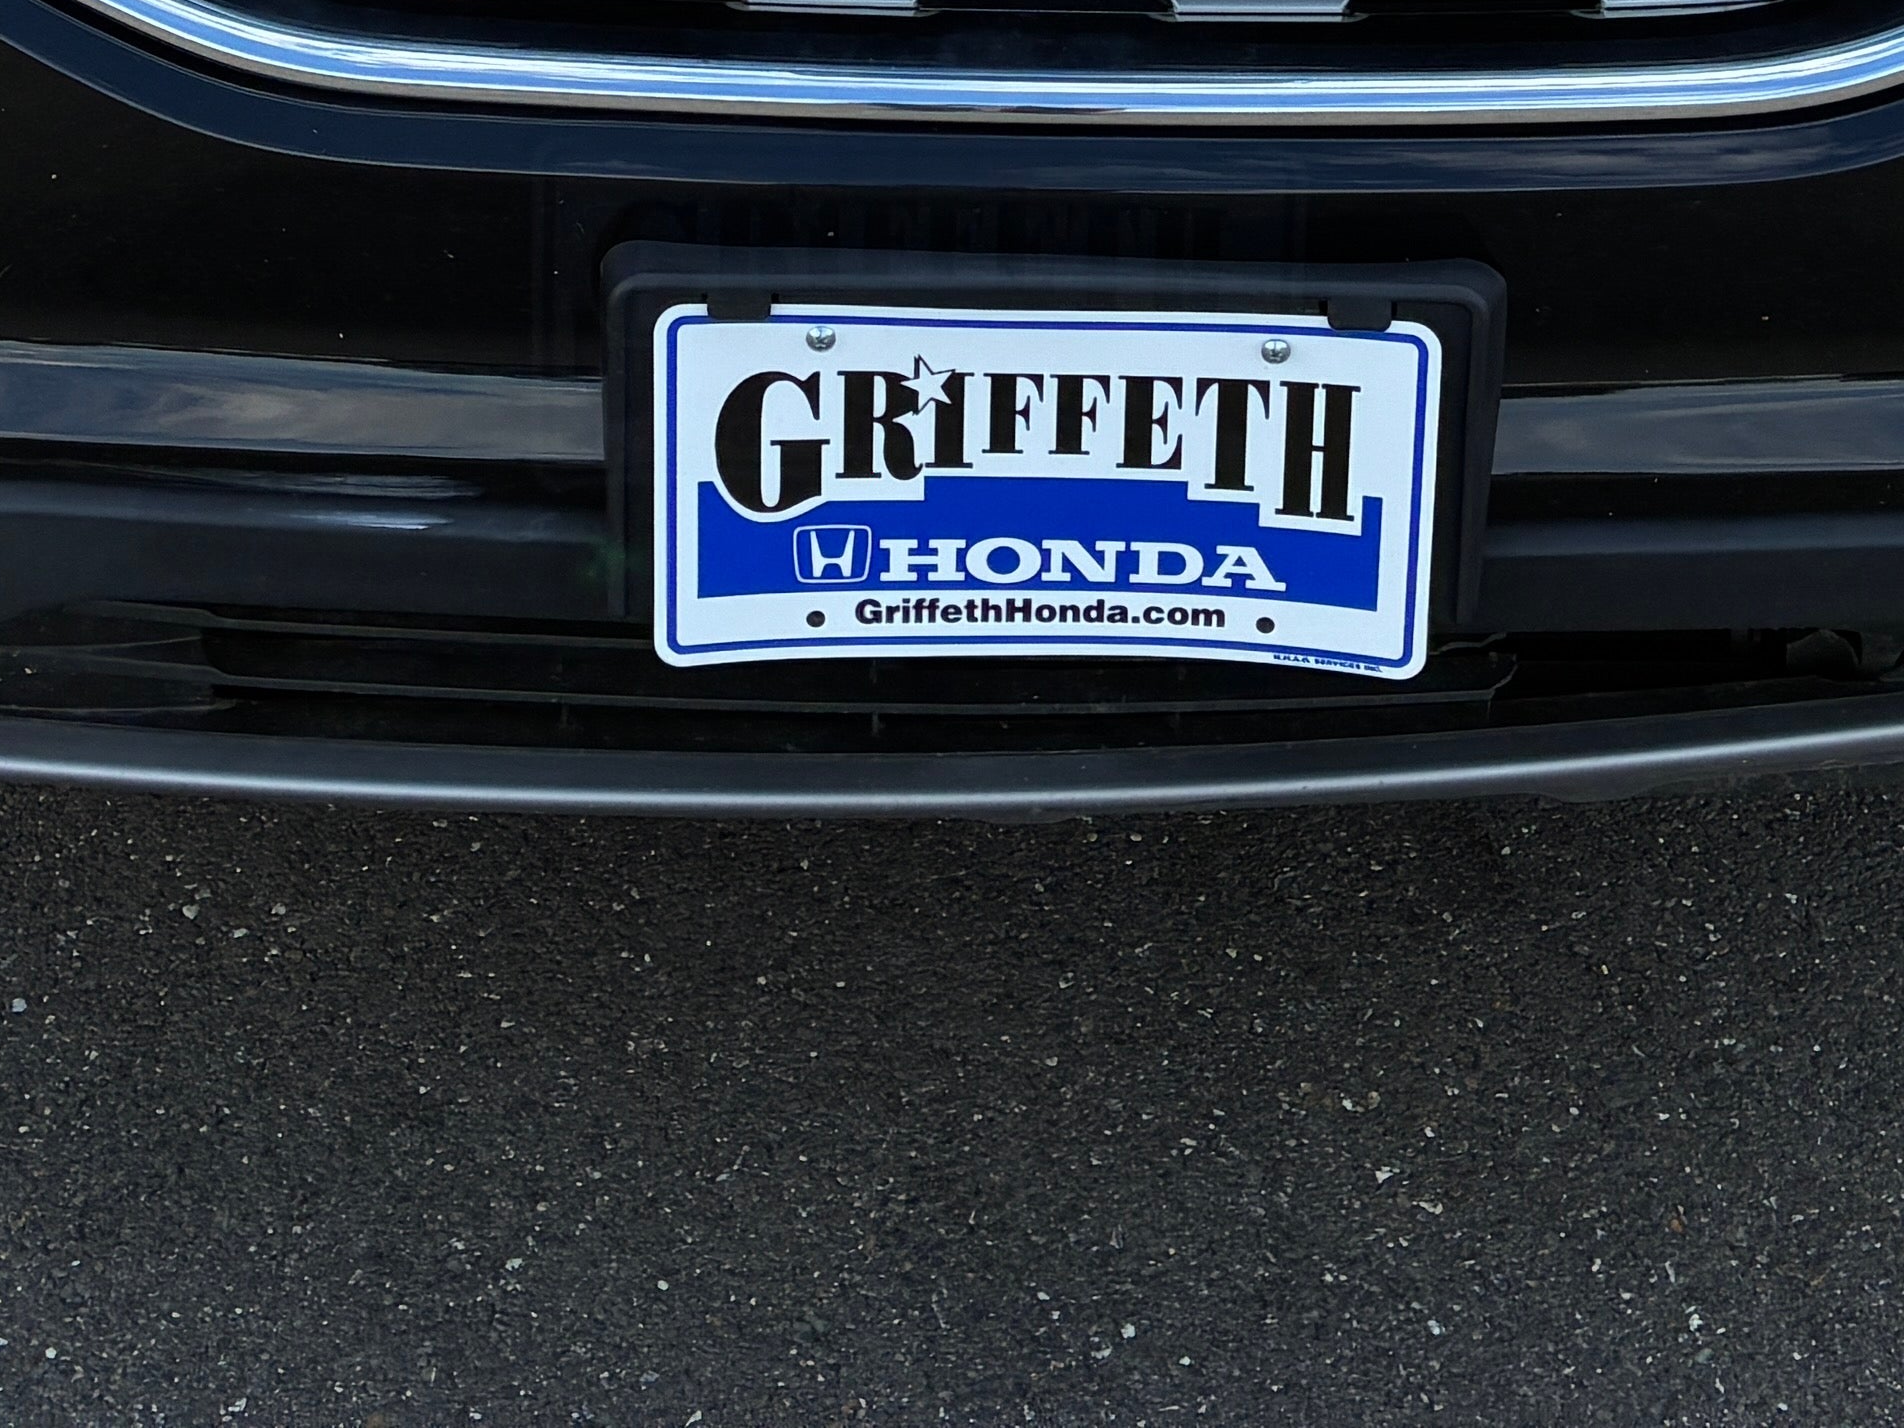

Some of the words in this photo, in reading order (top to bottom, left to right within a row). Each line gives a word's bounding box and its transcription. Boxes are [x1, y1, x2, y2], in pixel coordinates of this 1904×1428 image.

[714, 369, 1362, 523] GRIFFETH
[879, 537, 1287, 593] HONDA
[854, 597, 1226, 628] GriffethHonda.com
